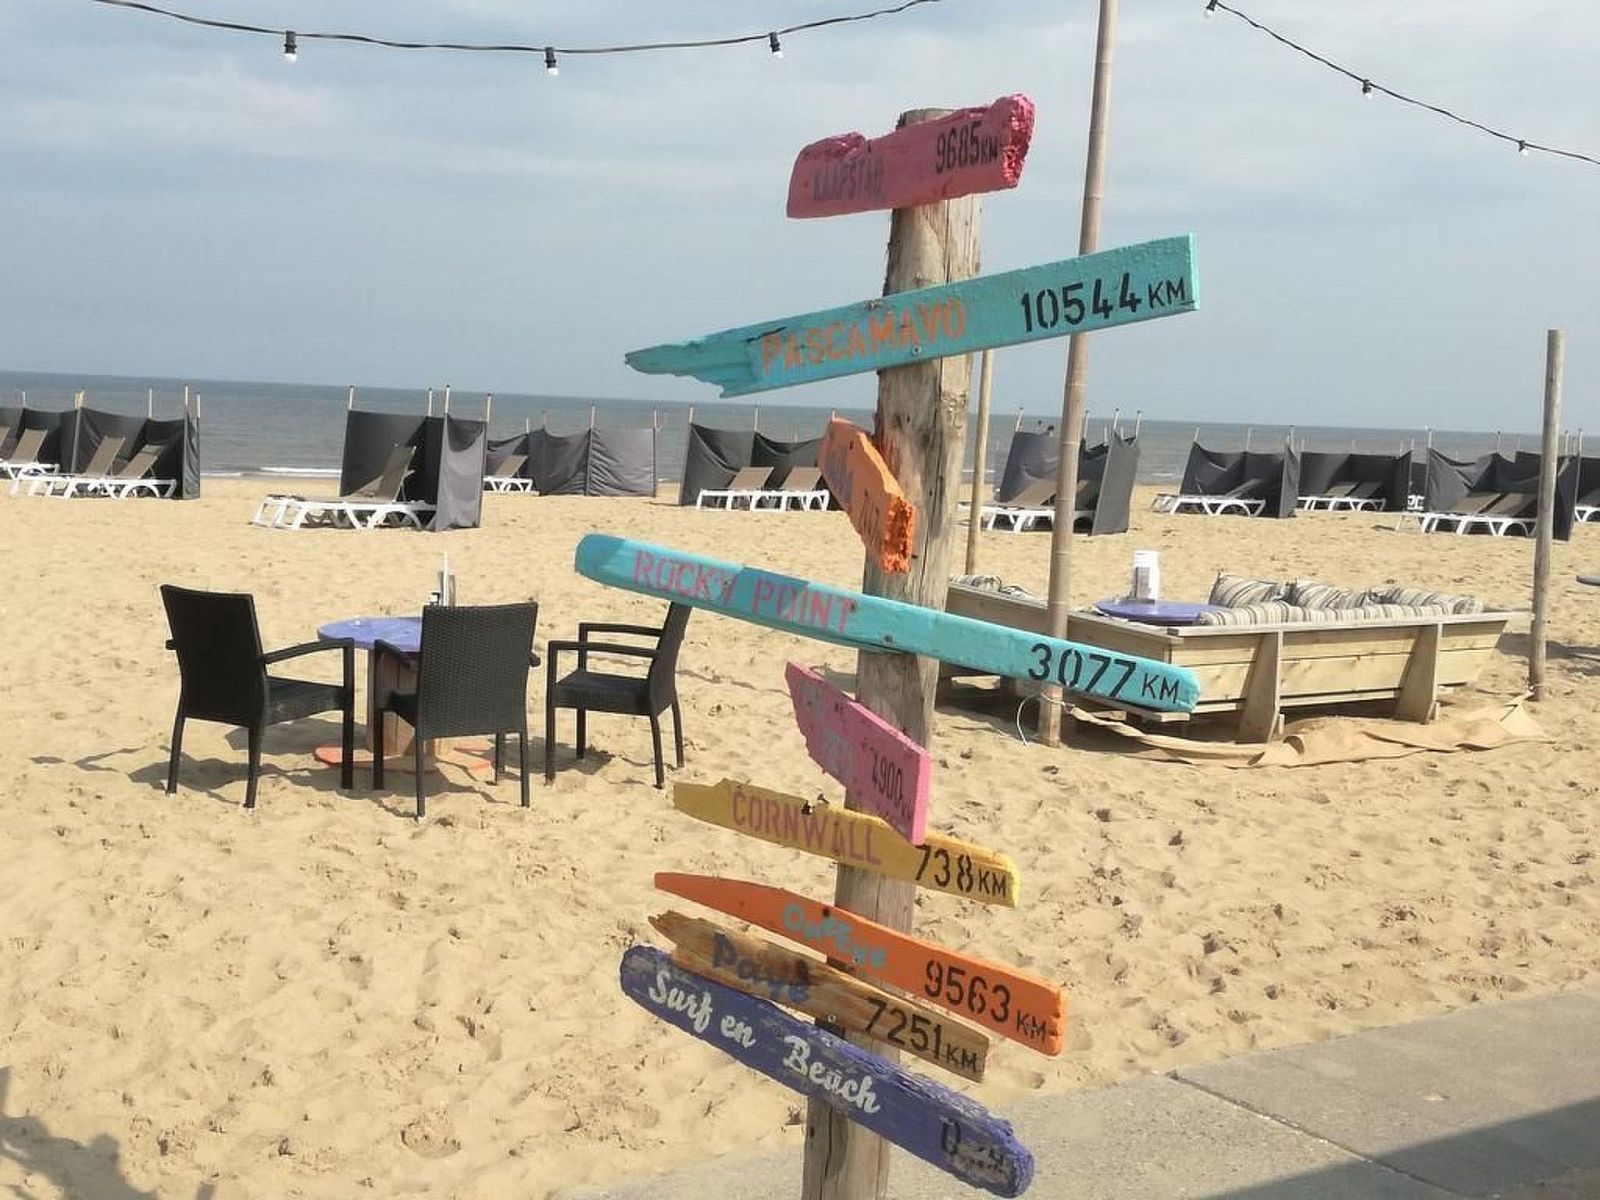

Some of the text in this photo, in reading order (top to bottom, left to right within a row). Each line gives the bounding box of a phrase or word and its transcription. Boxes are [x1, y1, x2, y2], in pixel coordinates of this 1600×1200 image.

[762, 272, 1187, 375] PASCAMAYO 10544 KM
[633, 550, 1181, 704] ROCKY POINT 3077 KM
[730, 791, 1008, 899] CORNWALL 738 KM
[648, 970, 881, 1114] Surf en Beach
[864, 997, 942, 1054] 7251
[946, 1044, 978, 1073] KM
[924, 959, 1011, 1023] 9563
[1016, 1010, 1048, 1041] KM
